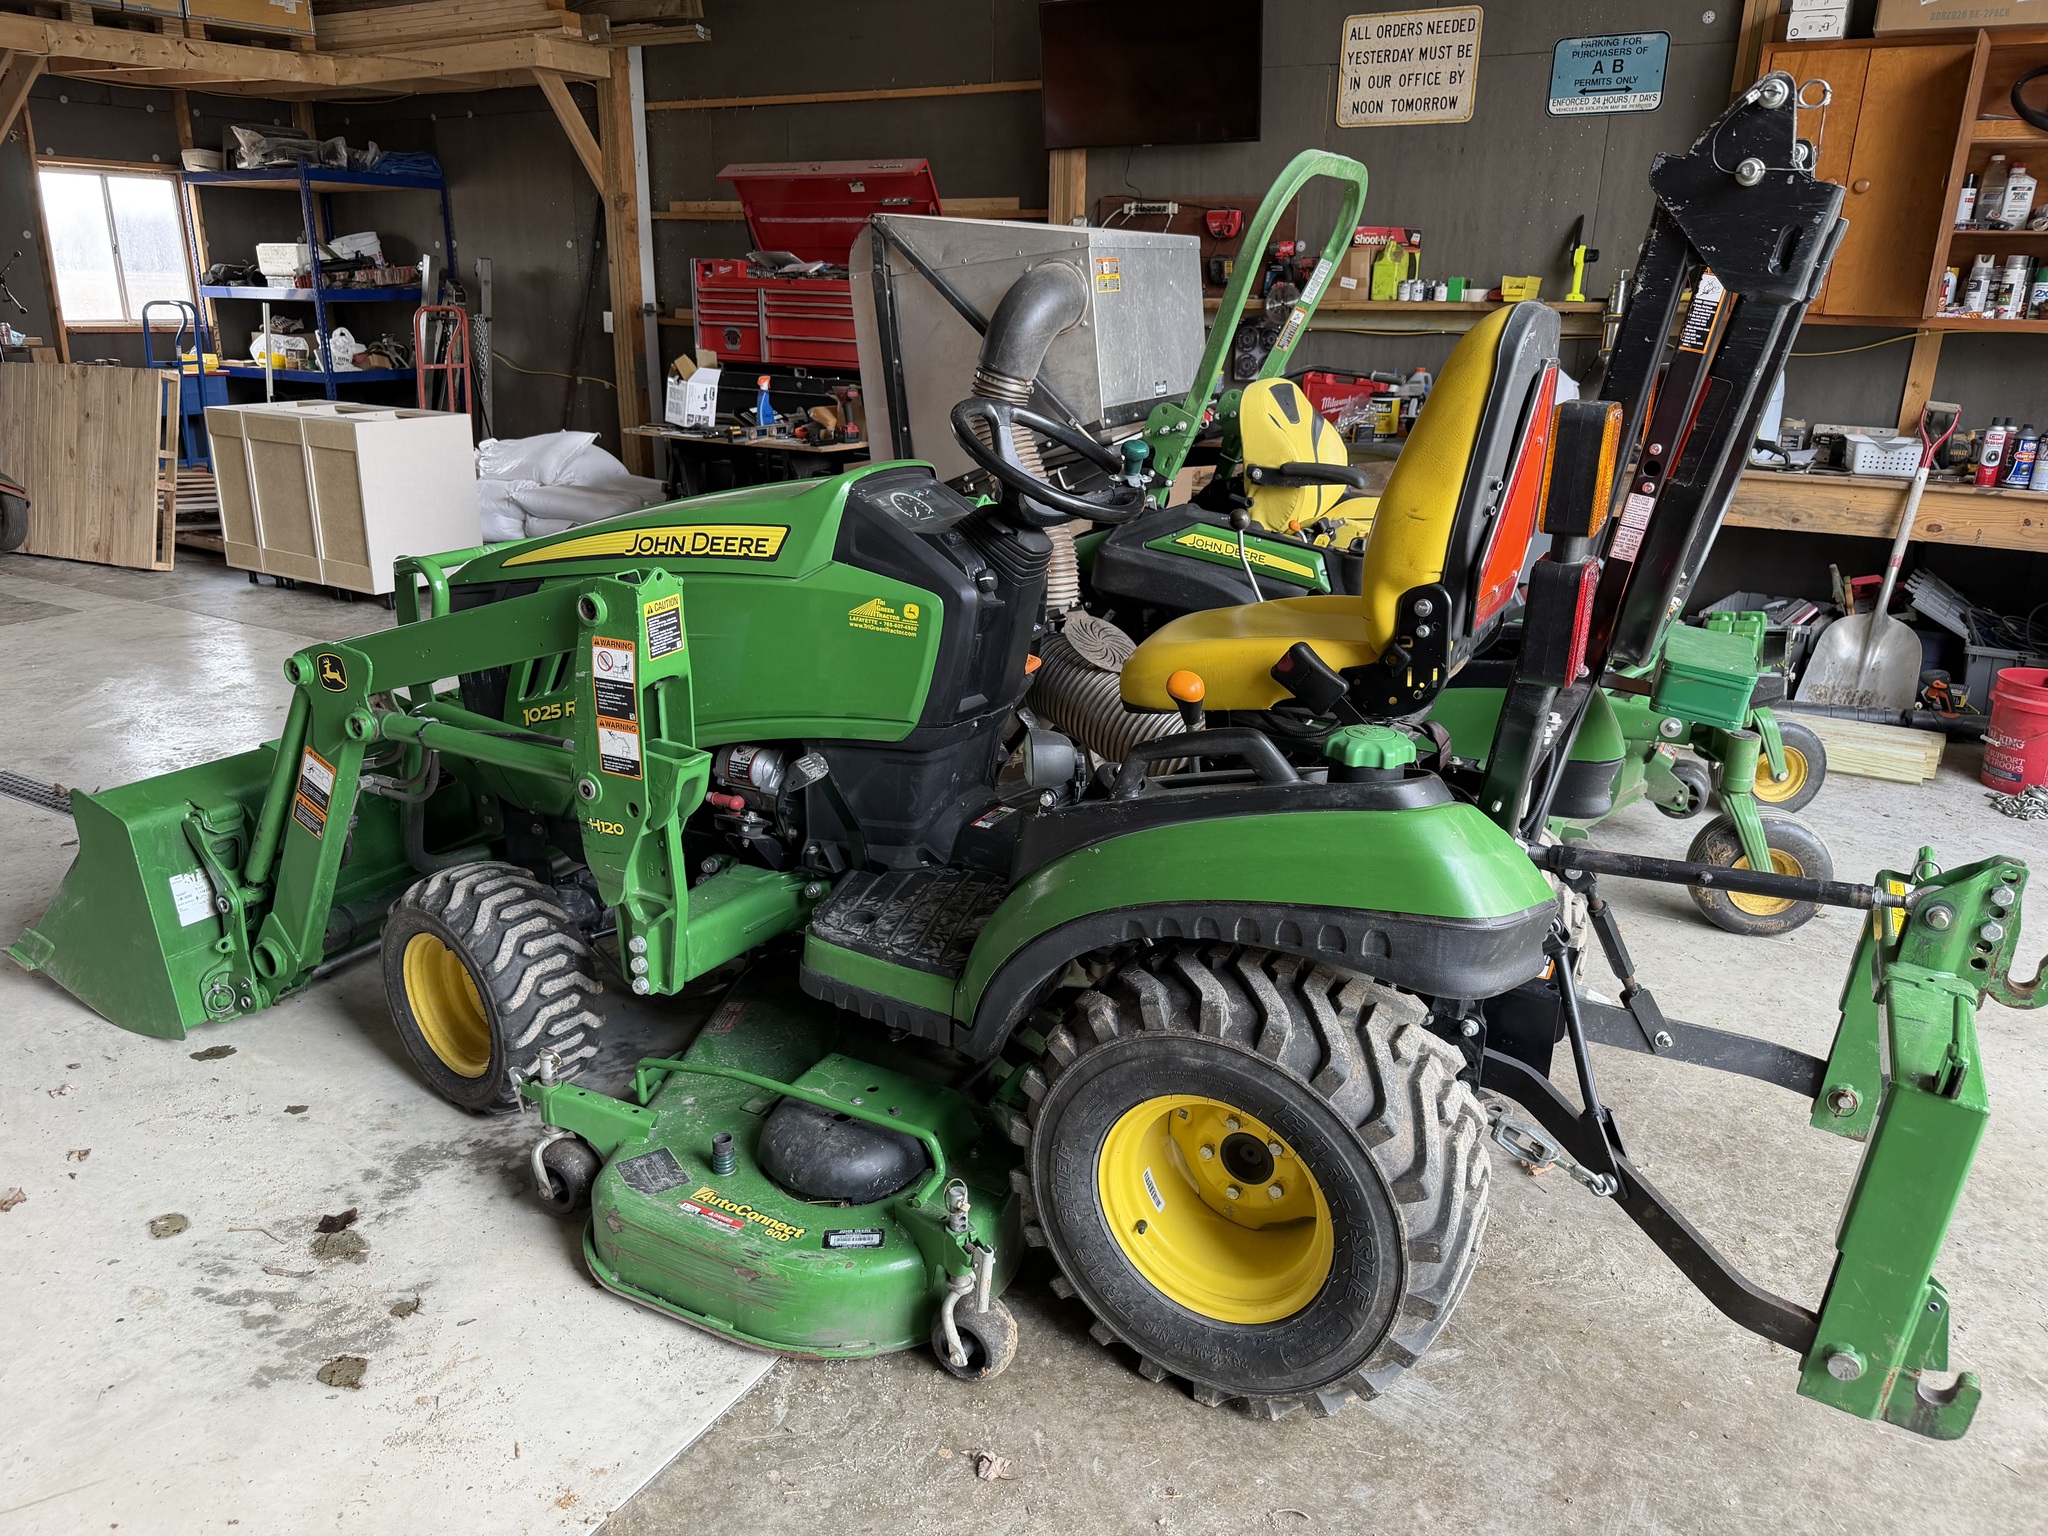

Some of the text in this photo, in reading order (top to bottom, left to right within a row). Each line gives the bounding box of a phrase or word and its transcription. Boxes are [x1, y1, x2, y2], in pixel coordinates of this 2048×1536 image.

[1350, 18, 1476, 41] ALL ORDERS NEEDED
[1580, 36, 1642, 49] PARKING FOR
[1348, 44, 1473, 65] YESTERDAY MUST BE
[1571, 46, 1649, 59] PURCHASERS OF
[1591, 58, 1625, 75] A B
[1349, 70, 1465, 90] IN OUR OFFICE BY
[1574, 76, 1639, 87] PERMITS ONLY
[1352, 96, 1459, 115] NOON TOMORROW
[1551, 97, 1590, 107] ENFORCED
[1592, 96, 1601, 105] 24
[1639, 93, 1658, 102] DAYS
[624, 533, 770, 554] JOHN DEERE
[1187, 536, 1266, 564] JOHN DEERE
[654, 595, 679, 612] CAUTION
[849, 616, 878, 625] LAFAYETTE
[600, 639, 633, 651] WARNING
[523, 701, 575, 727] 1025 R
[605, 719, 637, 733] WARNING
[2000, 734, 2025, 749] KING
[313, 753, 333, 772] WARNING
[1990, 749, 2025, 765] SUPPORT
[1991, 758, 2024, 773] TROOPS
[303, 800, 324, 820] WARNING
[588, 818, 625, 836] H120
[692, 1186, 807, 1240] AutoConnect
[1274, 1104, 1376, 1311] CARLISLE
[764, 1227, 790, 1242] 60D
